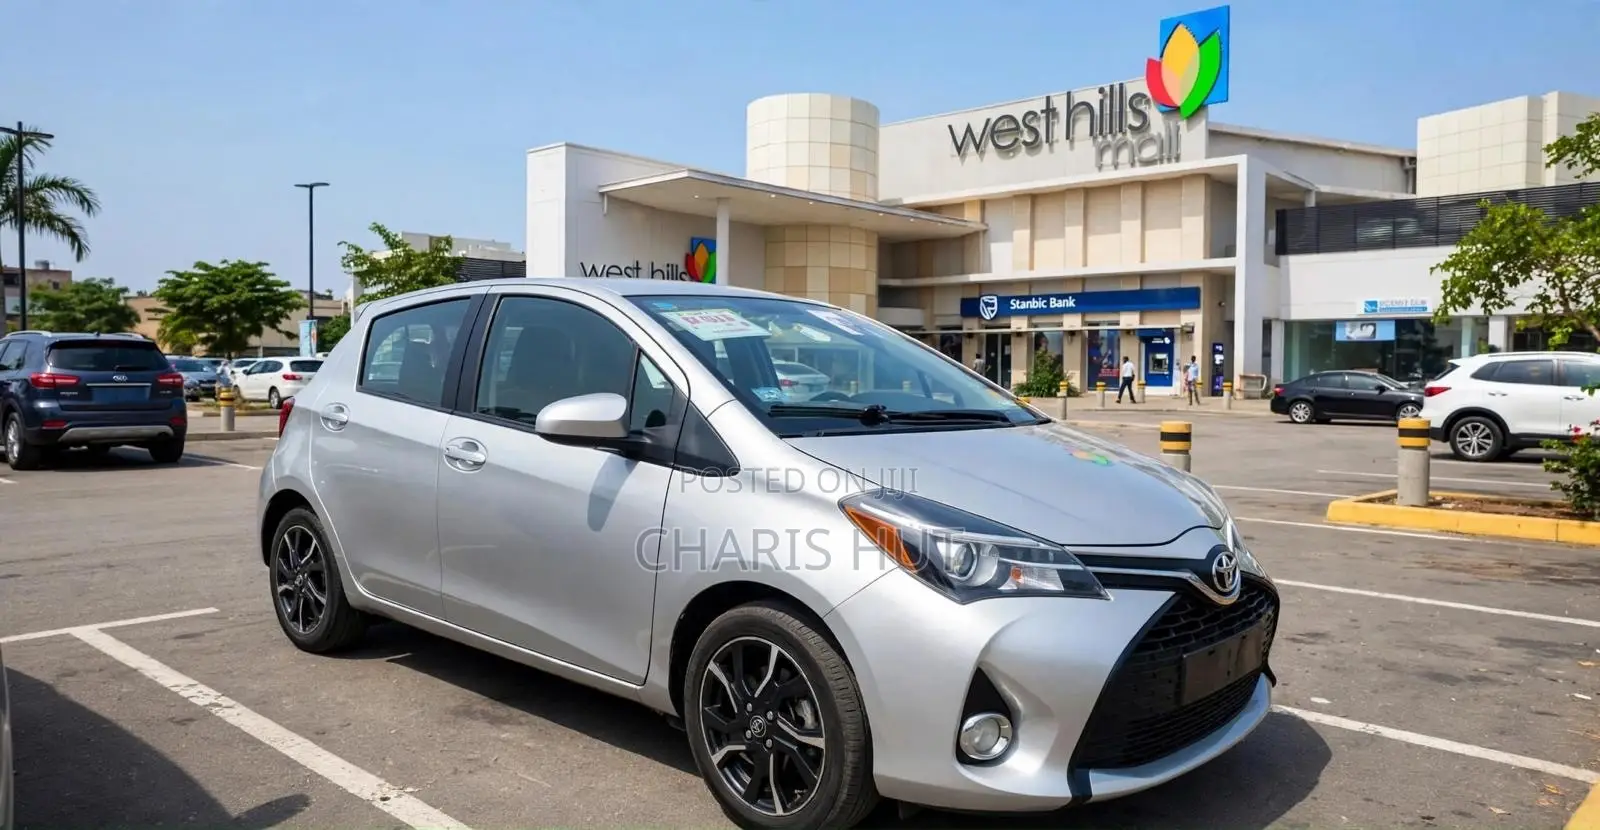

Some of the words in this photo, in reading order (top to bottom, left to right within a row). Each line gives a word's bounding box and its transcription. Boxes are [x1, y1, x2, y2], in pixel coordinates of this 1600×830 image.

[948, 95, 1057, 157] west
[1066, 82, 1151, 140] hills
[1096, 121, 1180, 168] mall
[1010, 297, 1047, 309] Stanbic
[1050, 296, 1076, 308] Bank
